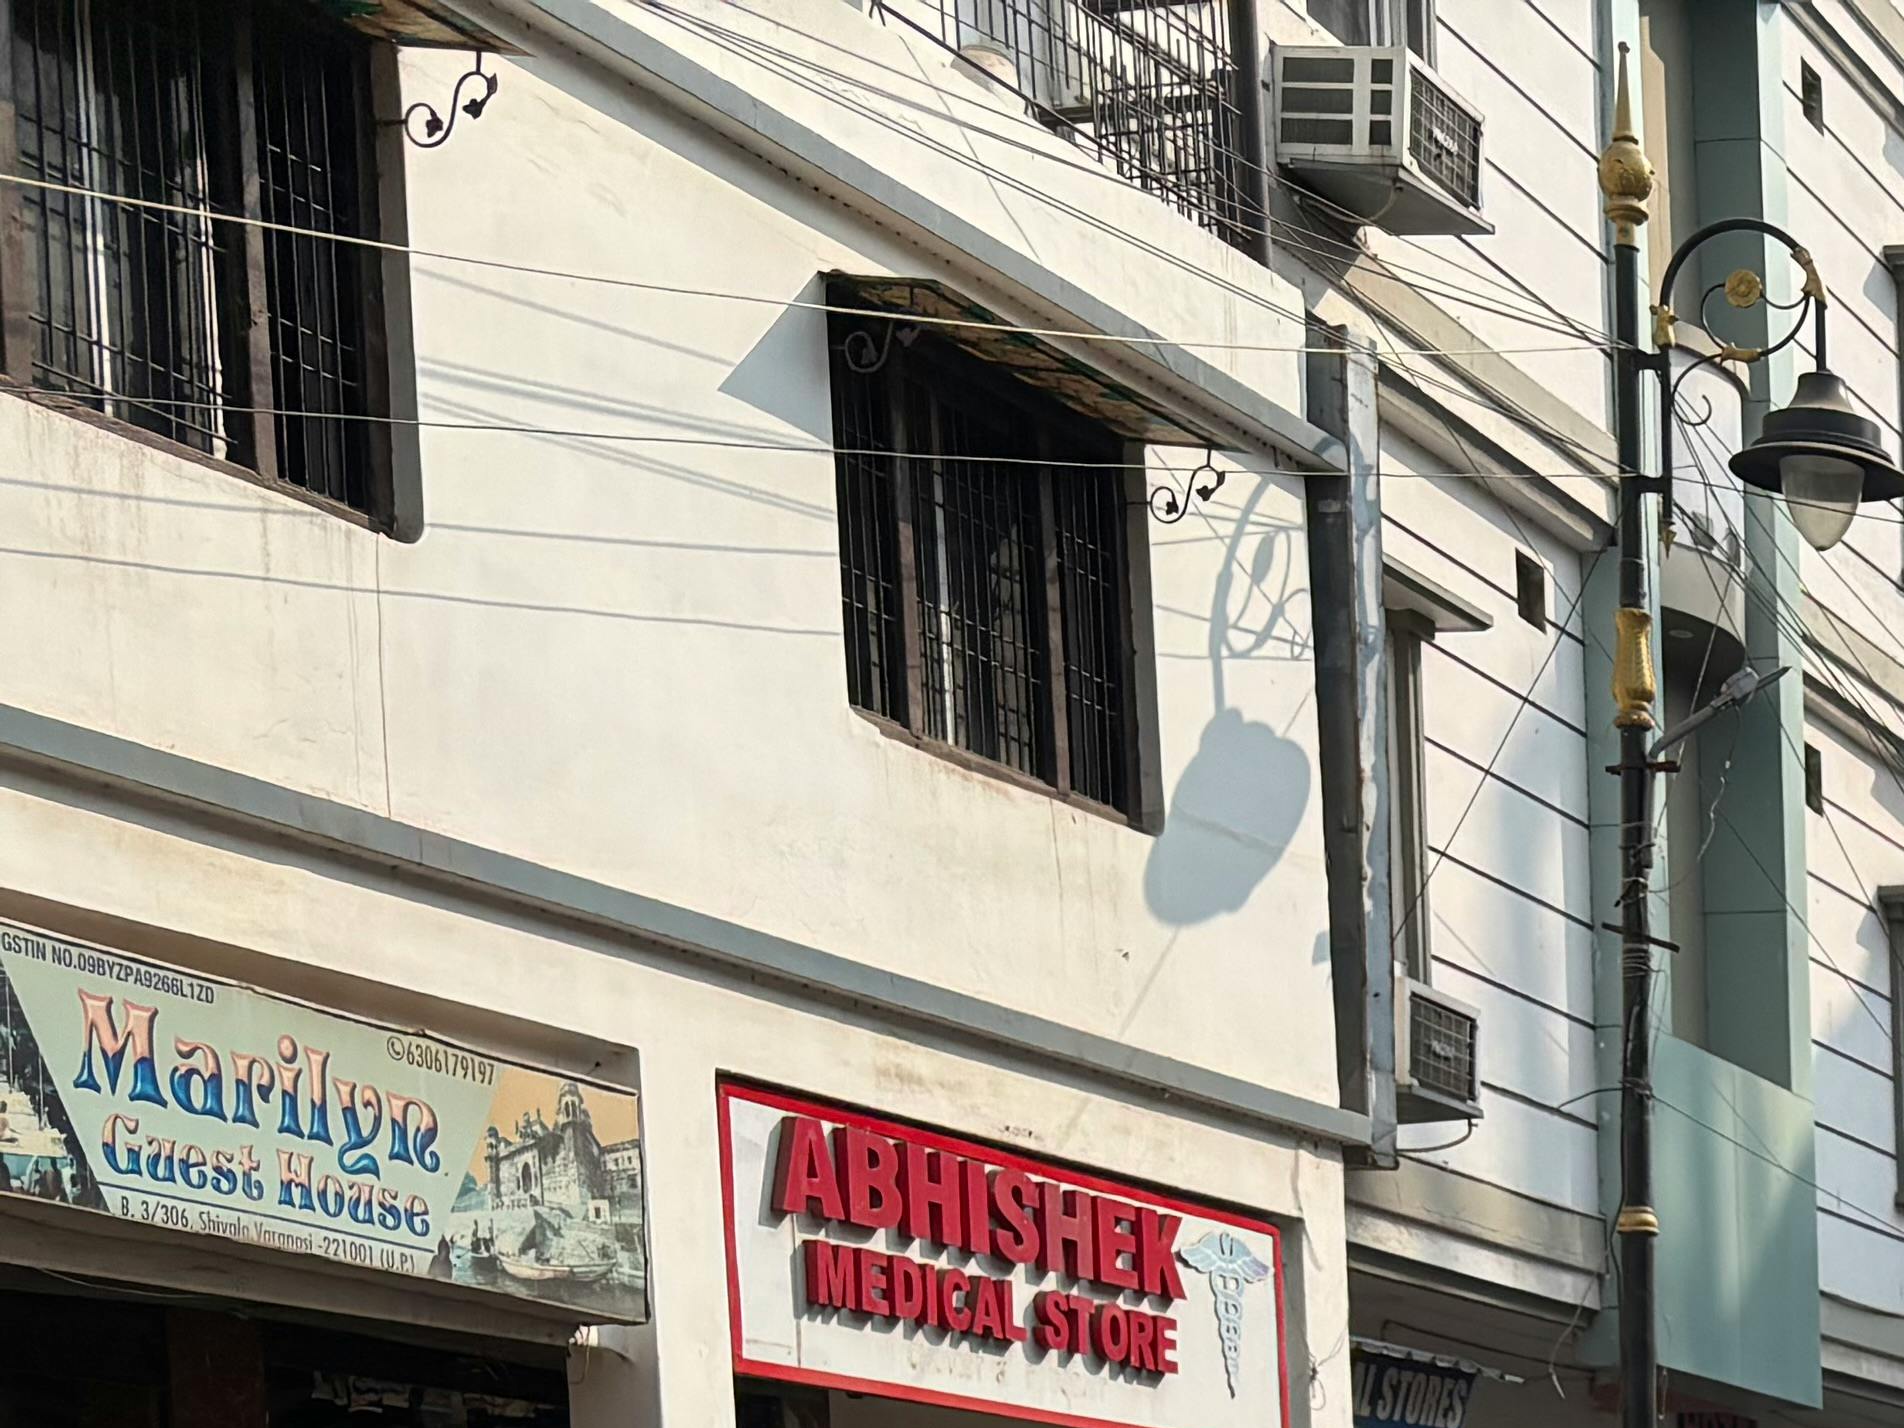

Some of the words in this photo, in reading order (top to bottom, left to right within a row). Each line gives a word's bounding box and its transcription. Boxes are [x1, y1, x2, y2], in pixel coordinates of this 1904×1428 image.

[2, 932, 46, 961] GSTIN
[73, 988, 441, 1177] Marilyn
[405, 1043, 495, 1087] 6306179197
[101, 1112, 264, 1202] Guest
[275, 1146, 431, 1238] House
[773, 1116, 1186, 1300] ABHISHEK
[802, 1239, 1026, 1342] MEDICAL
[1034, 1291, 1178, 1374] STORE
